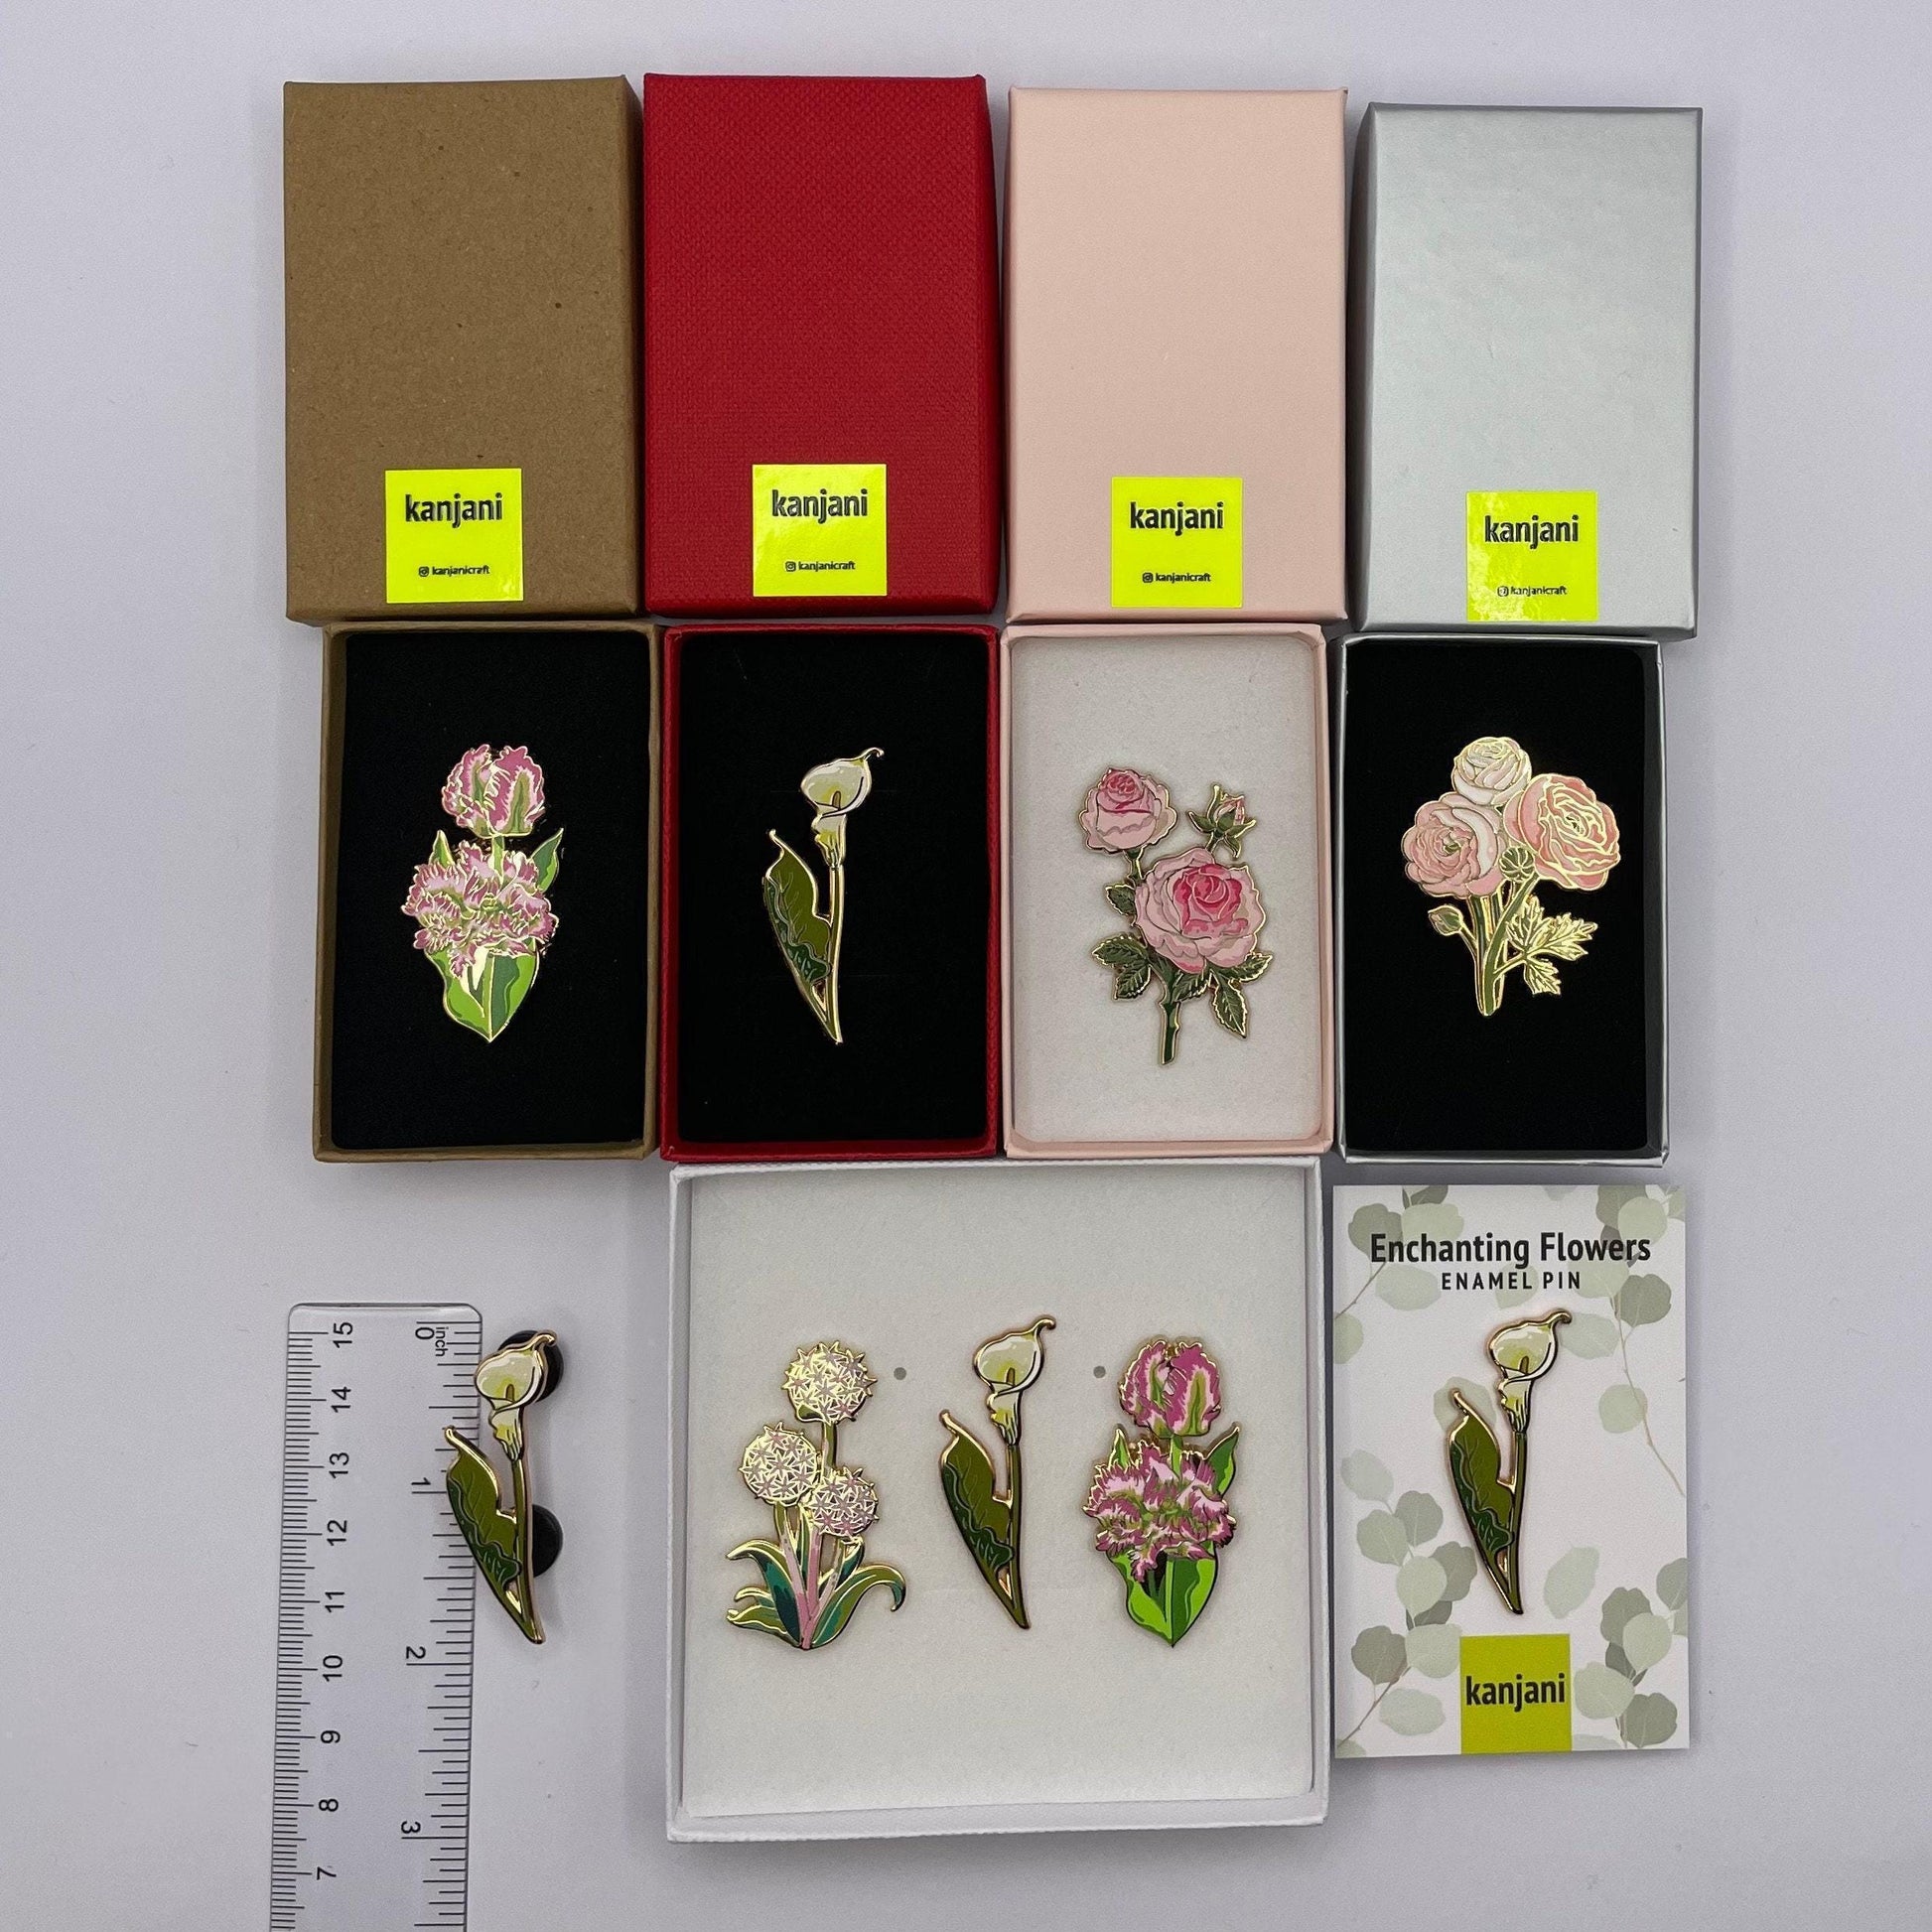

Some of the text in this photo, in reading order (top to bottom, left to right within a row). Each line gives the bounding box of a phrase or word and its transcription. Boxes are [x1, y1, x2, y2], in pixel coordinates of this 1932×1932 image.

[405, 491, 502, 529] kanjani
[771, 487, 869, 525] kanjani
[1130, 501, 1224, 537] kanjani
[1484, 514, 1580, 550] kanjani
[432, 564, 490, 577] kanjanicraft
[797, 560, 856, 572] kanjanicraft
[1155, 572, 1211, 584] kanjanicraft
[1510, 585, 1568, 597] kanjanicraft
[1370, 1231, 1651, 1270] Enchanting Flowers
[1442, 1271, 1581, 1291] ENAMEL PIN
[333, 1321, 353, 1349] 15
[414, 1326, 434, 1341] 0
[434, 1326, 450, 1358] inch
[331, 1386, 351, 1414] 14
[329, 1451, 349, 1479] 13
[411, 1477, 432, 1486] 1
[326, 1519, 347, 1547] 12
[324, 1591, 345, 1613] 11
[405, 1646, 427, 1660] 2
[322, 1655, 344, 1683] 10
[1465, 1672, 1566, 1713] kanjani
[320, 1729, 342, 1744] 9
[318, 1798, 340, 1813] 8
[400, 1821, 421, 1835] 3
[316, 1866, 337, 1880] 7
